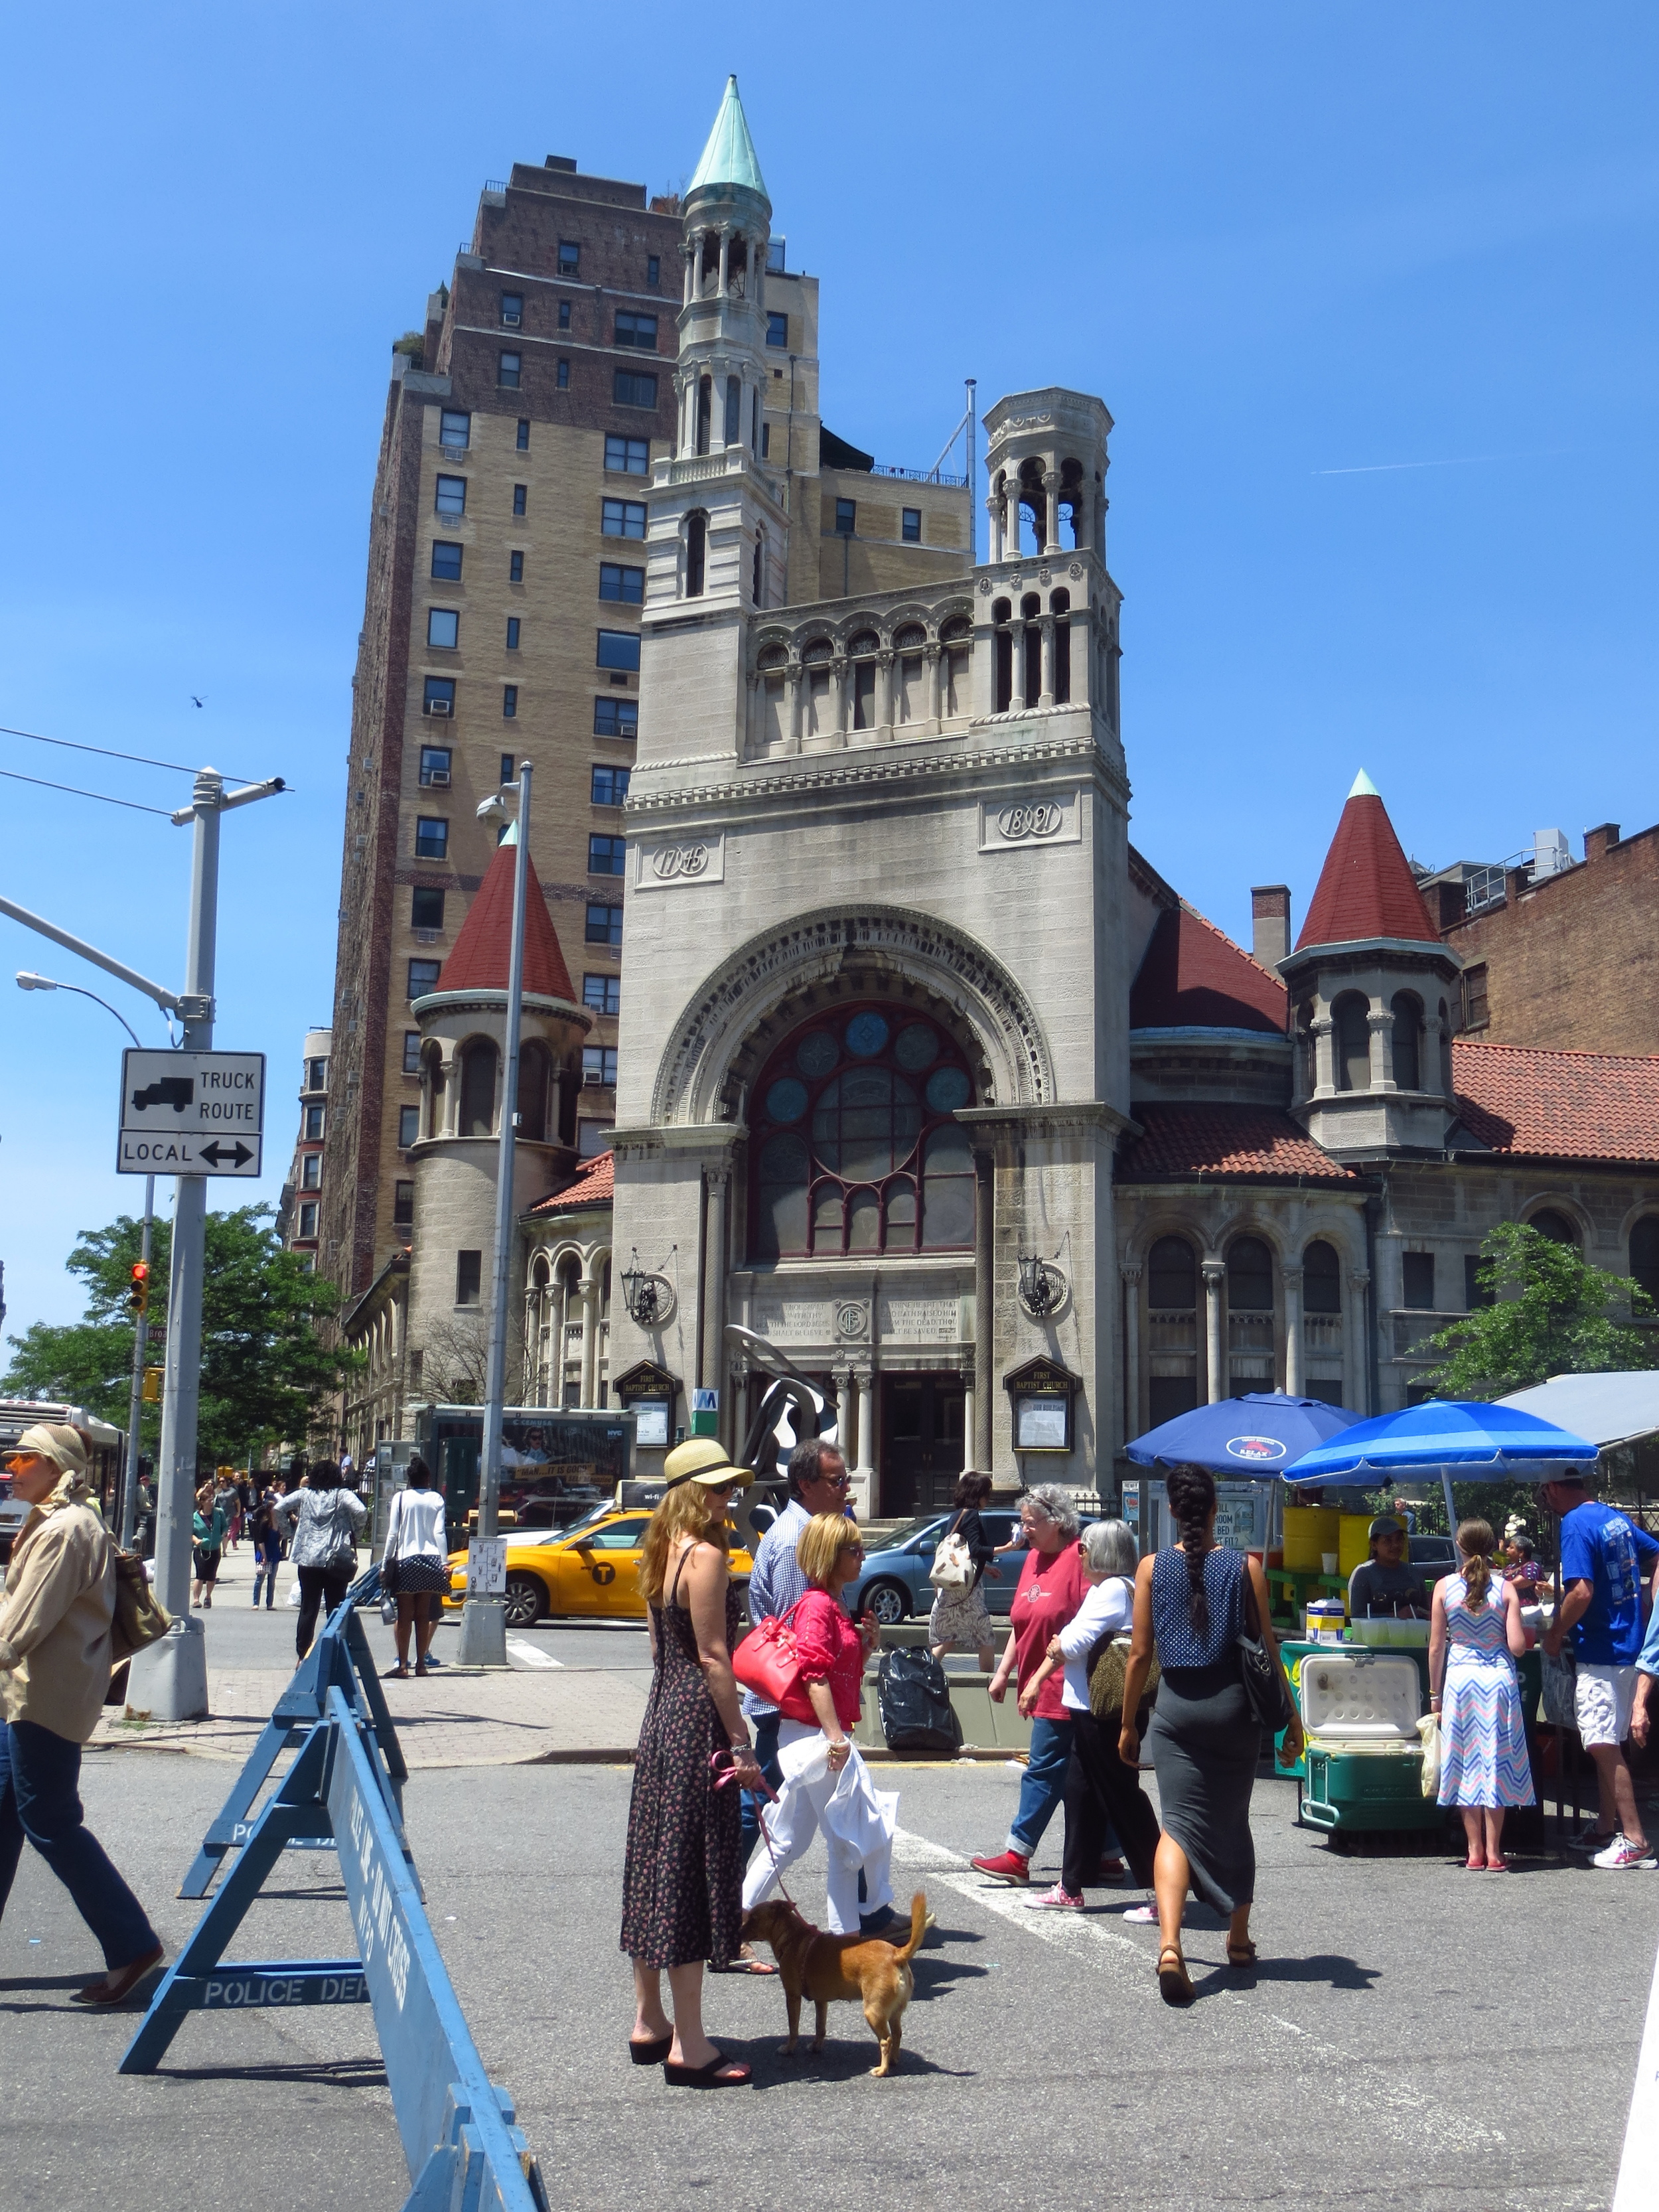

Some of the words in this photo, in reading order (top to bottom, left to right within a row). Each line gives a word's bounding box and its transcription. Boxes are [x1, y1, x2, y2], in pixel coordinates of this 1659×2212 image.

[201, 1072, 255, 1089] TRUCK
[200, 1103, 253, 1120] ROUTE
[124, 1143, 192, 1161] LOCAL
[1218, 1526, 1230, 1535] BED
[372, 1862, 384, 1917] DO
[378, 1881, 393, 1949] NOT
[388, 1915, 411, 2012] CROSS
[204, 1979, 305, 2004] POLICE
